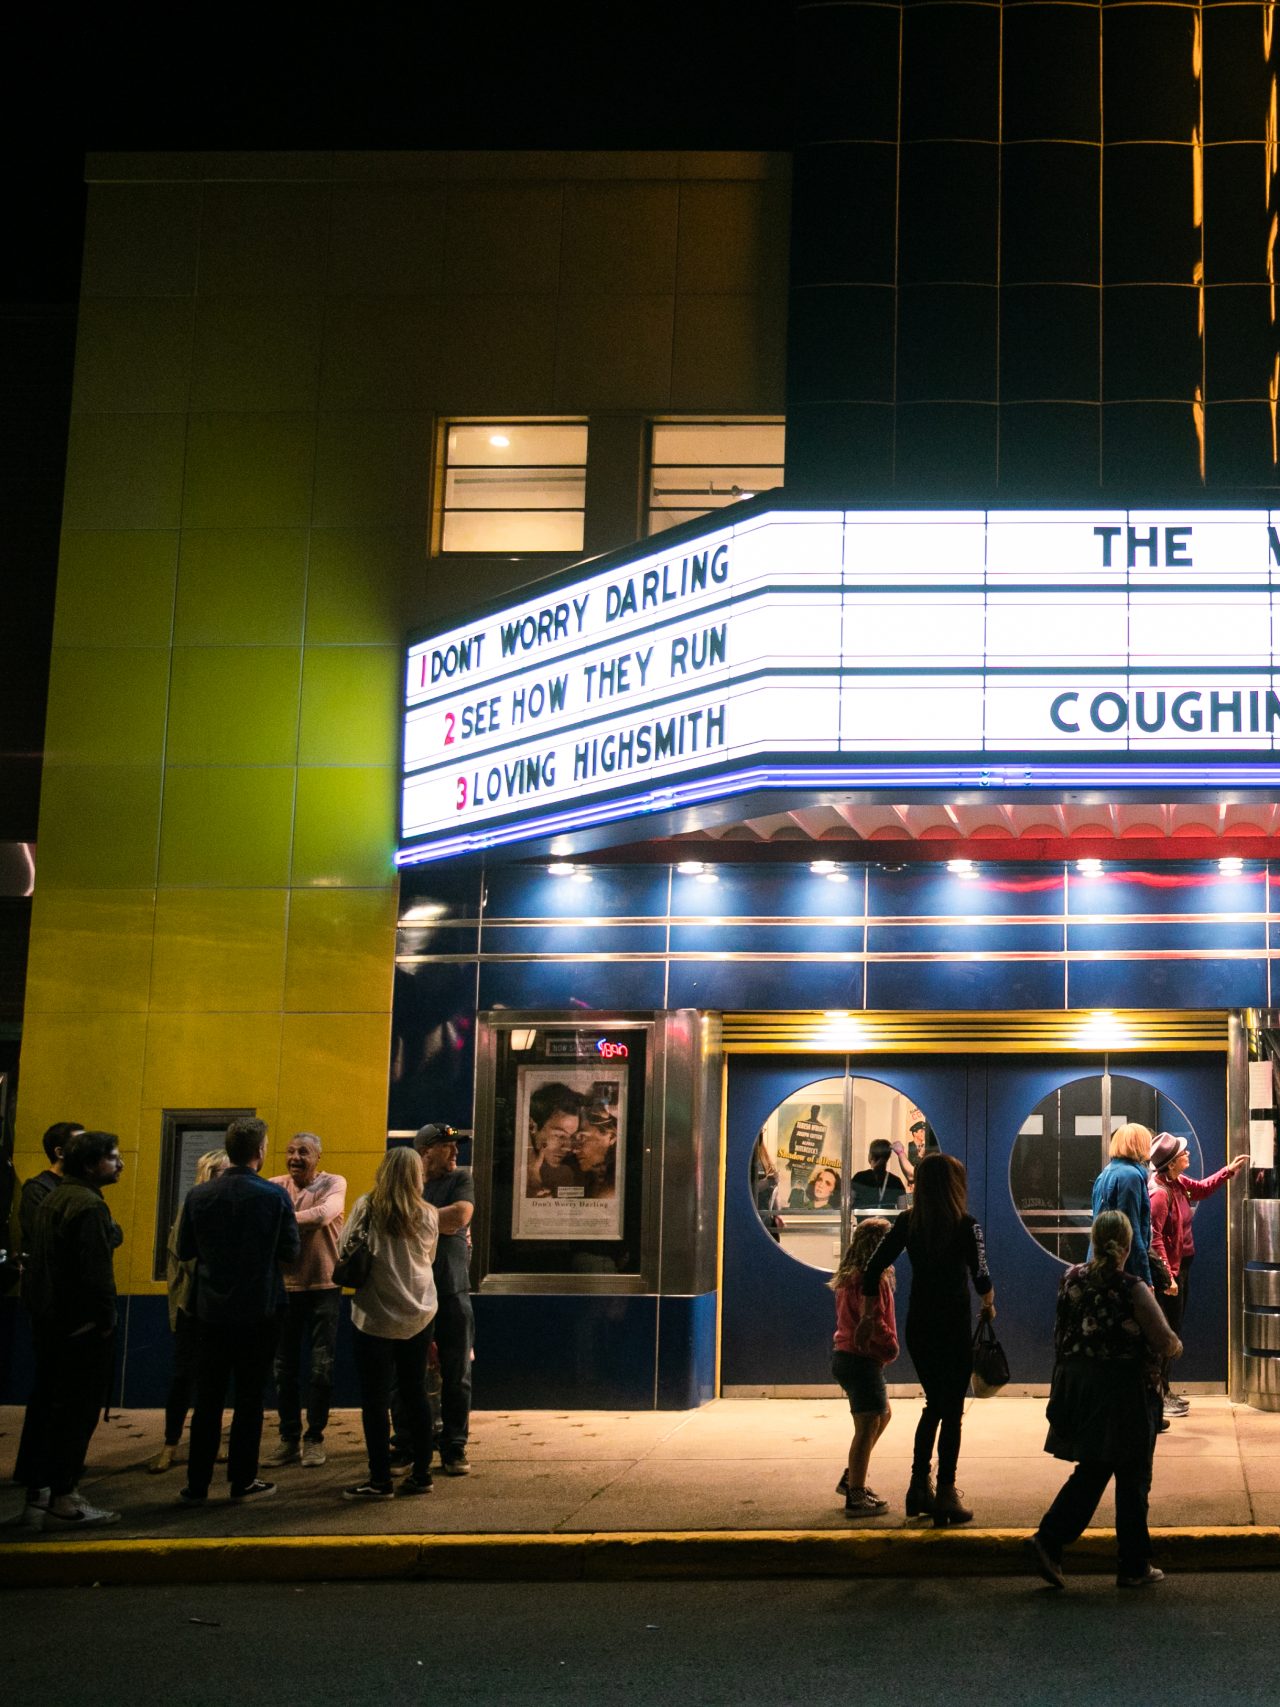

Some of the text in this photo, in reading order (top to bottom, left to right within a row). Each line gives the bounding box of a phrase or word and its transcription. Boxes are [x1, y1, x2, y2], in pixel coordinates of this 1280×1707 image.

[1094, 526, 1192, 567] THE
[420, 544, 729, 687] 1 DONT WORRY DARLING
[444, 624, 728, 746] 2 SEE HOW THEY RUN
[456, 704, 726, 810] 3 LOVING HIGHSMITH
